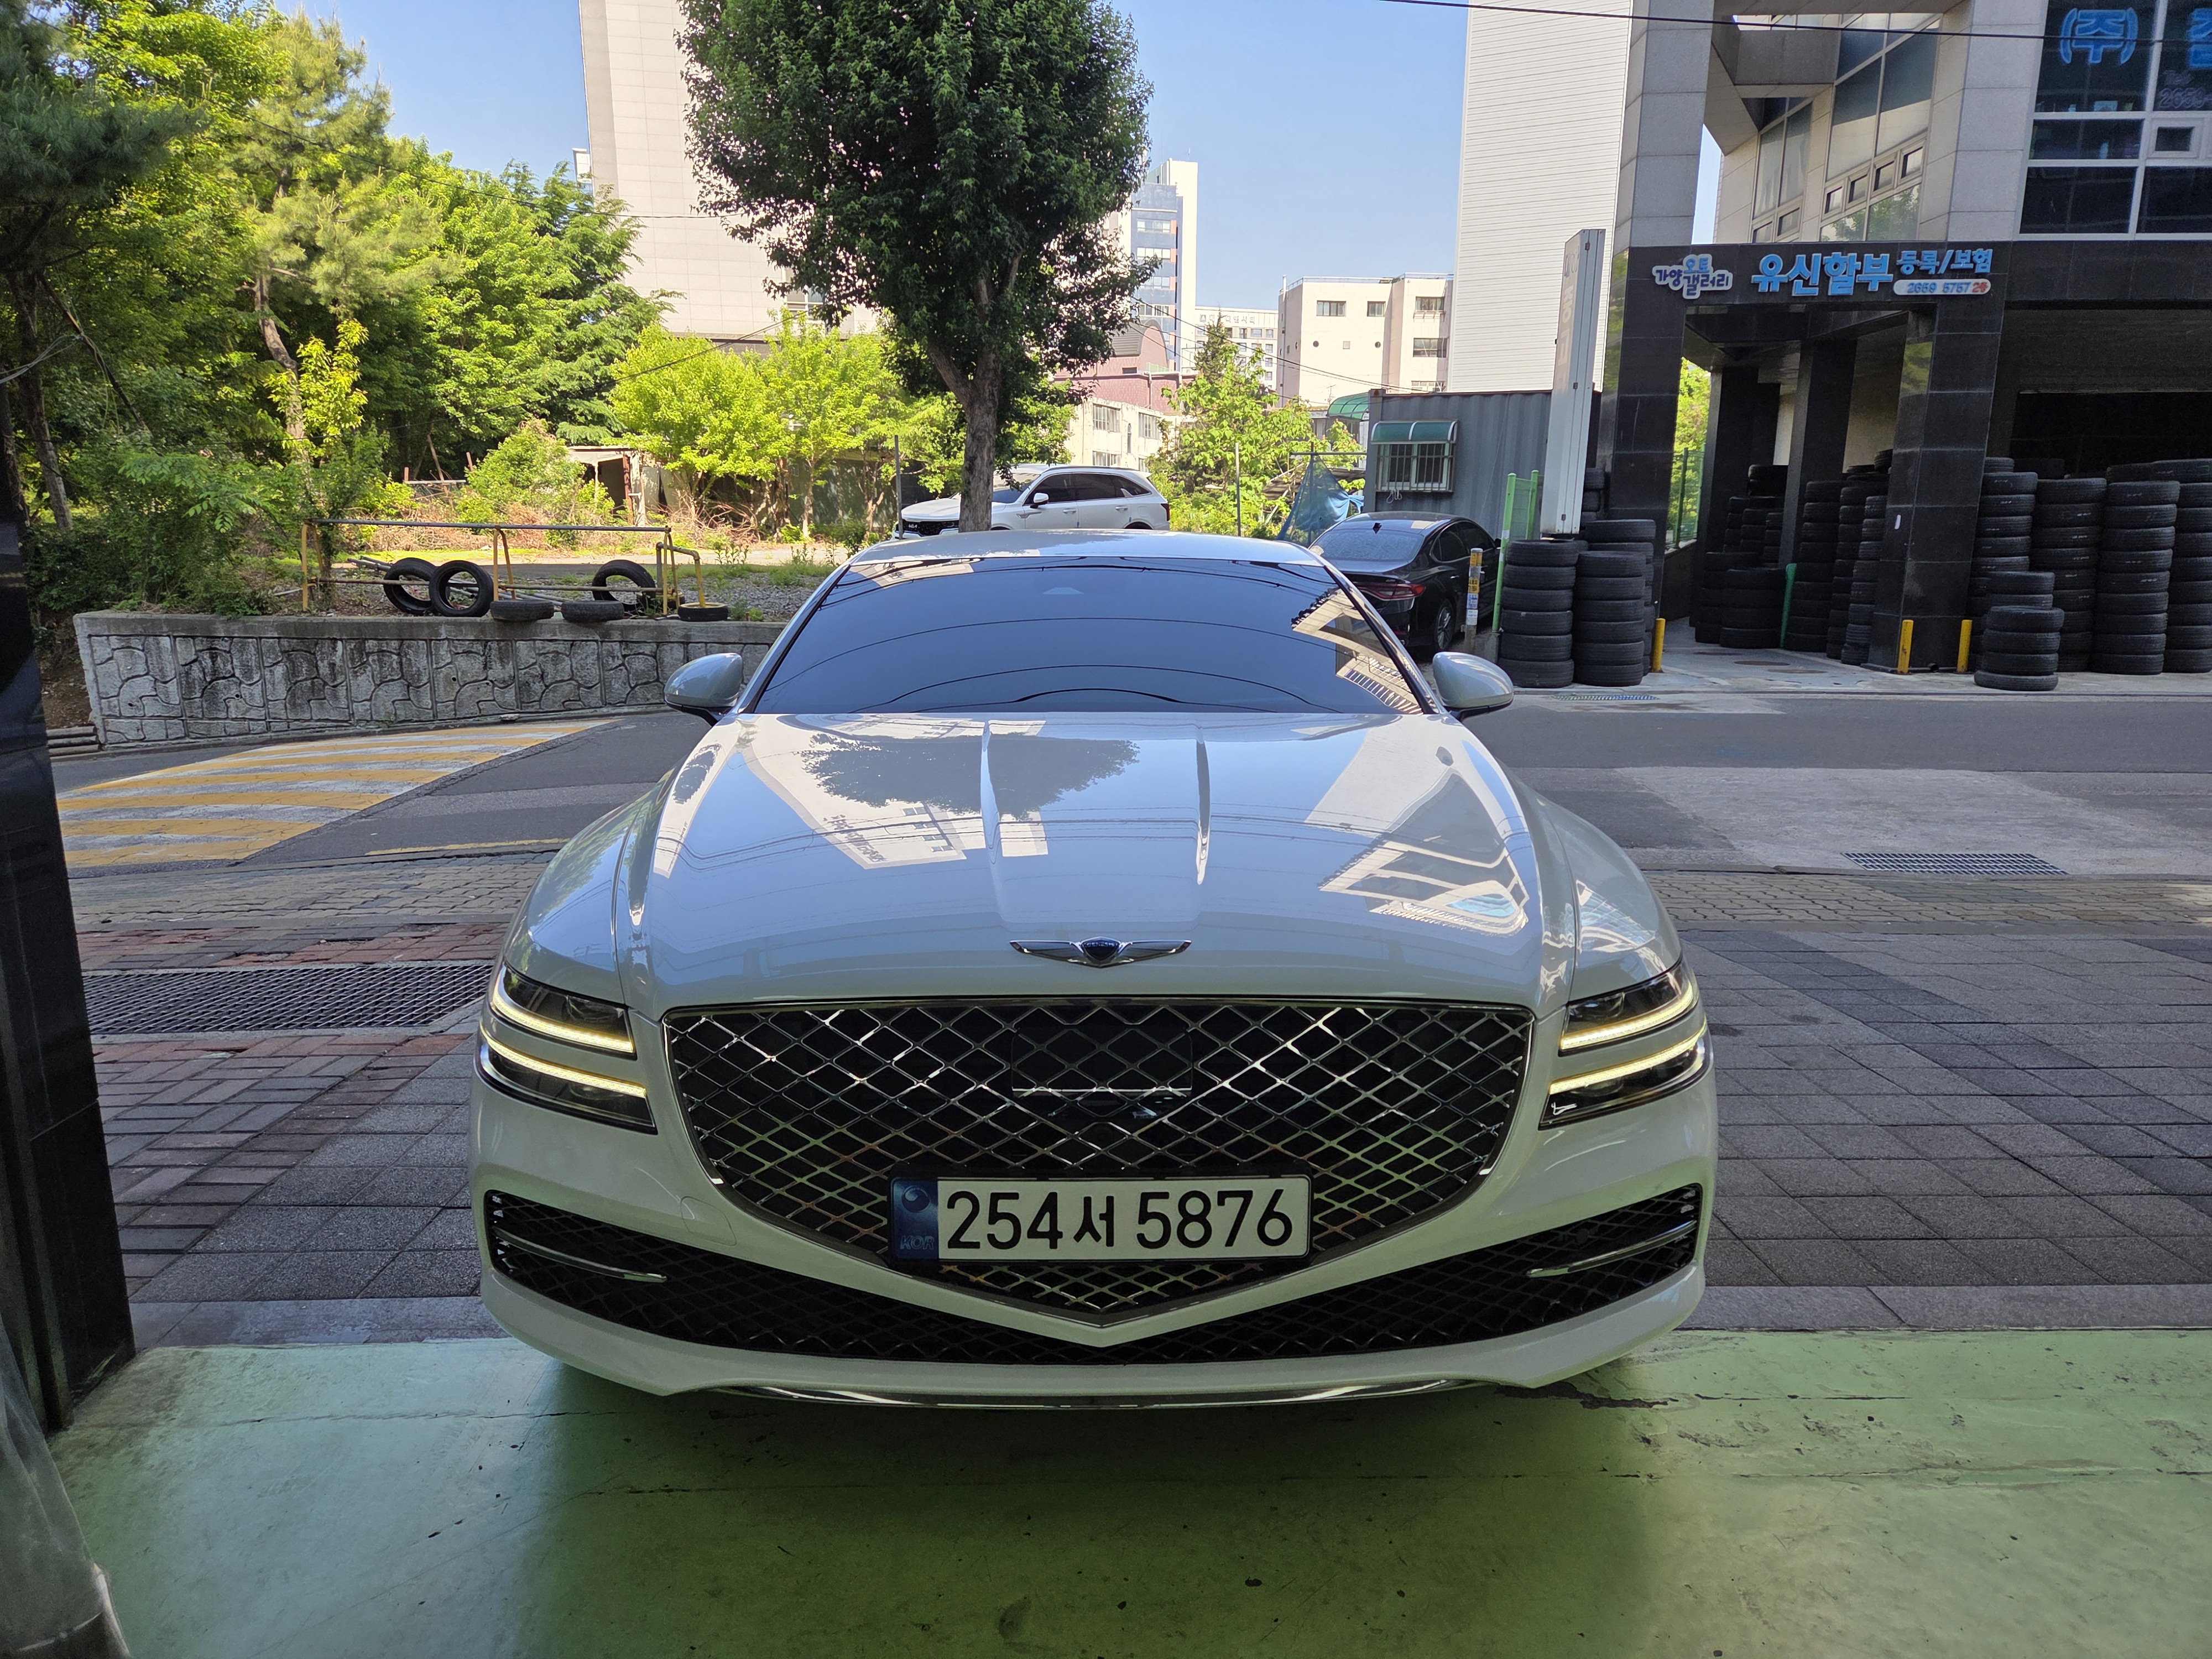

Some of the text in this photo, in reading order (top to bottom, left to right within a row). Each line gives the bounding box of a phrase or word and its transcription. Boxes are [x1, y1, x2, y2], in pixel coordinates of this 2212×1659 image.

[2060, 7, 2139, 65] (주)
[1683, 257, 1710, 274] 오토
[1751, 252, 1893, 296] 유신할부
[1896, 248, 1993, 275] 등록/보험
[1655, 269, 1729, 296] 가양 갤러리
[1907, 281, 1937, 294] 2659
[946, 1189, 1293, 1249] 254서 5876
[900, 1235, 935, 1250] KOR
